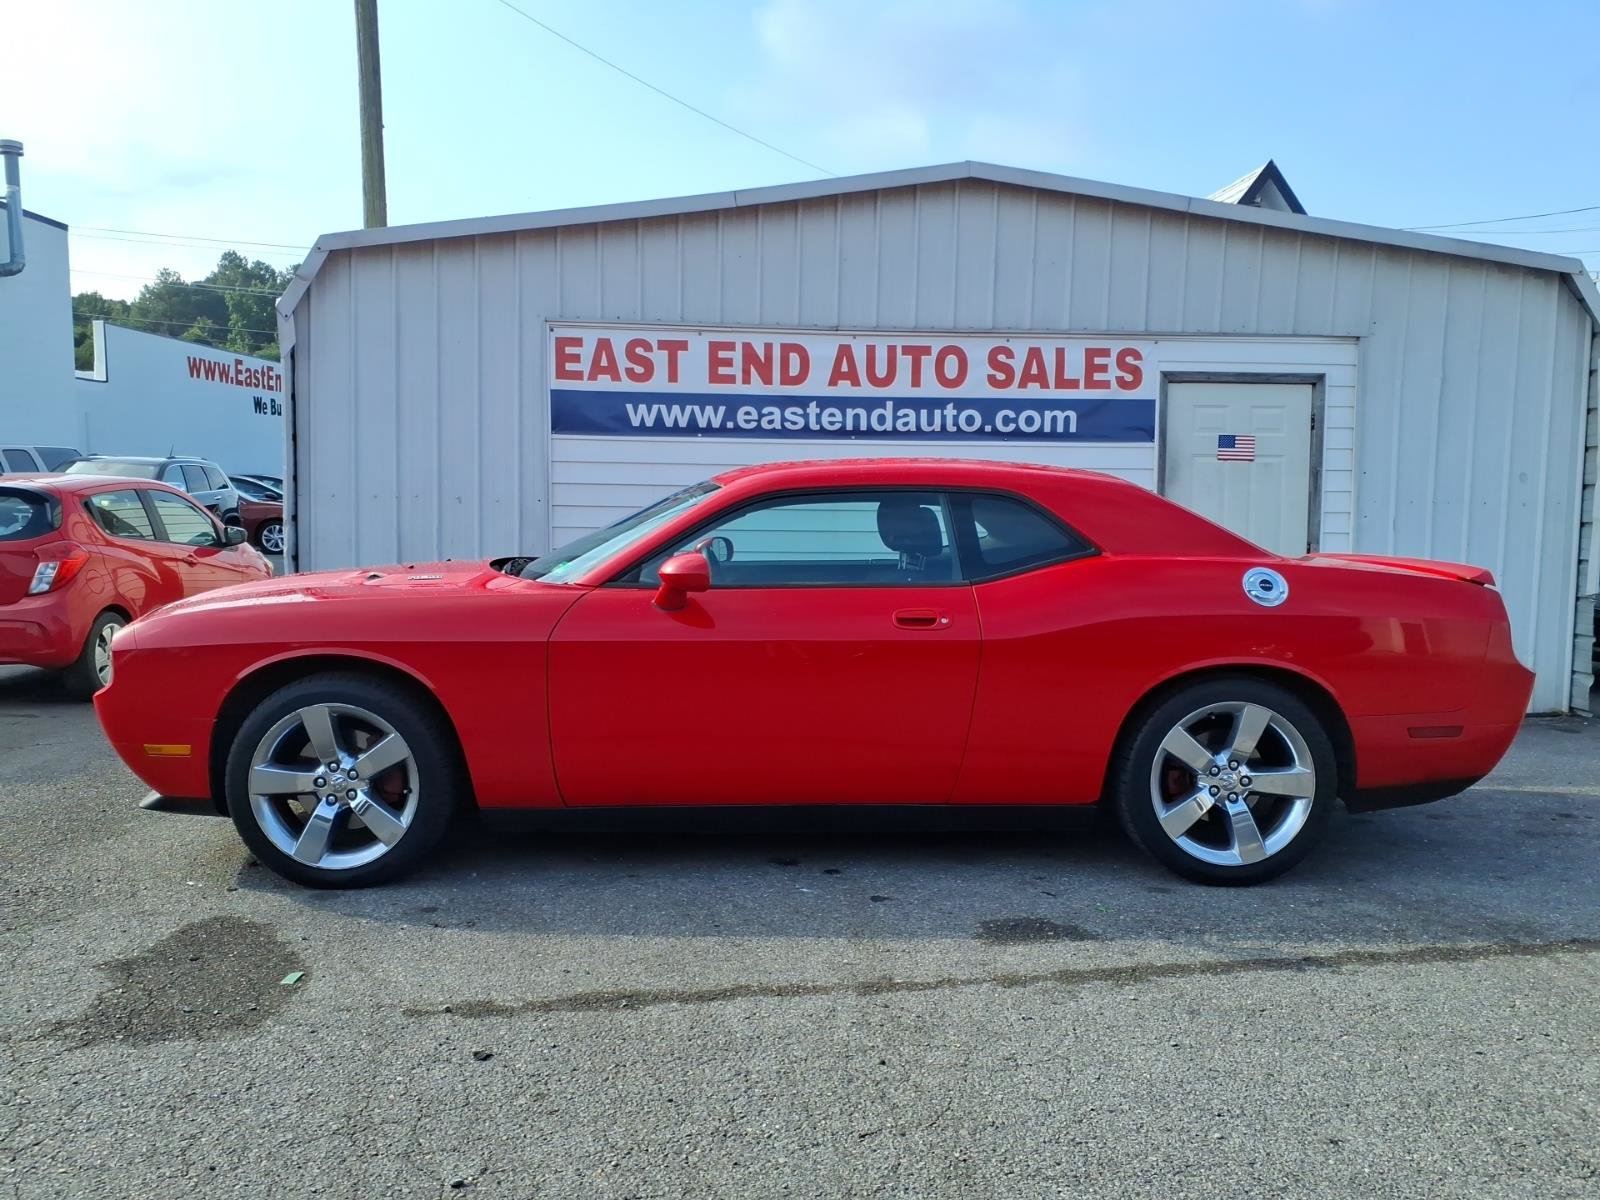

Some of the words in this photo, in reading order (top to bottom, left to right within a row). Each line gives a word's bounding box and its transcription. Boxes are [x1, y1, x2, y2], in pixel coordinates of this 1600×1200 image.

[554, 336, 689, 383] EAST
[708, 340, 811, 386] END
[827, 344, 968, 389] AUTO
[986, 346, 1143, 391] SALES
[253, 396, 268, 416] We
[625, 400, 1077, 433] www.eastendauto.com
